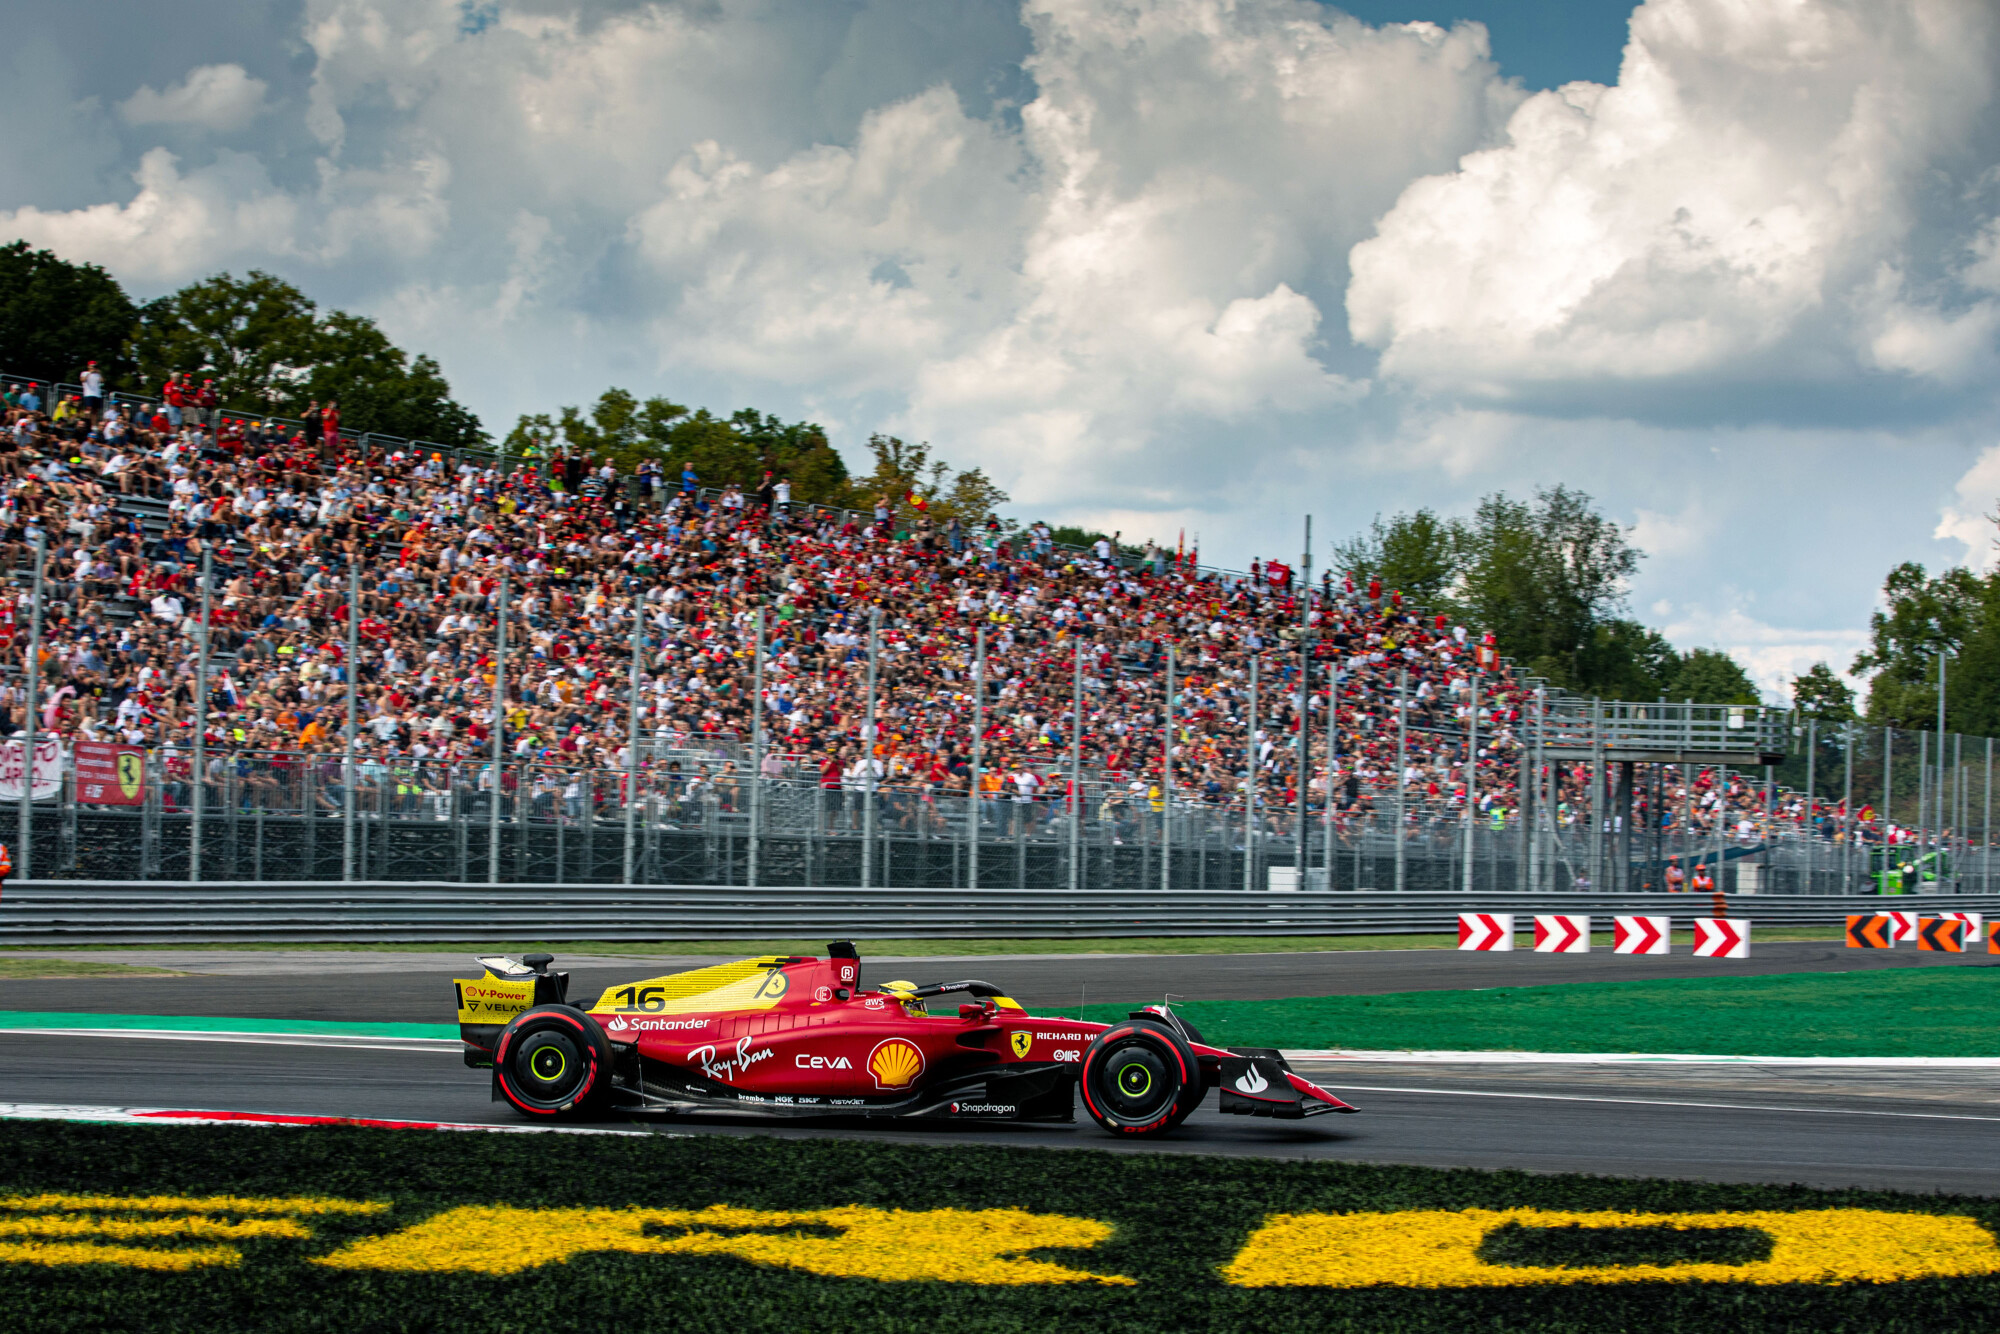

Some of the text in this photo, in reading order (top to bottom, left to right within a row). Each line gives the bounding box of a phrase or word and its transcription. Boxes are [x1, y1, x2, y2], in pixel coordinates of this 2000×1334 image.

[478, 988, 526, 1000] V-Power
[614, 987, 666, 1013] 16
[865, 998, 885, 1007] aws
[630, 1018, 711, 1032] Santander
[1036, 1032, 1081, 1041] RICHARD
[737, 1094, 765, 1103] brembo
[961, 1103, 1016, 1114] Snapdragon
